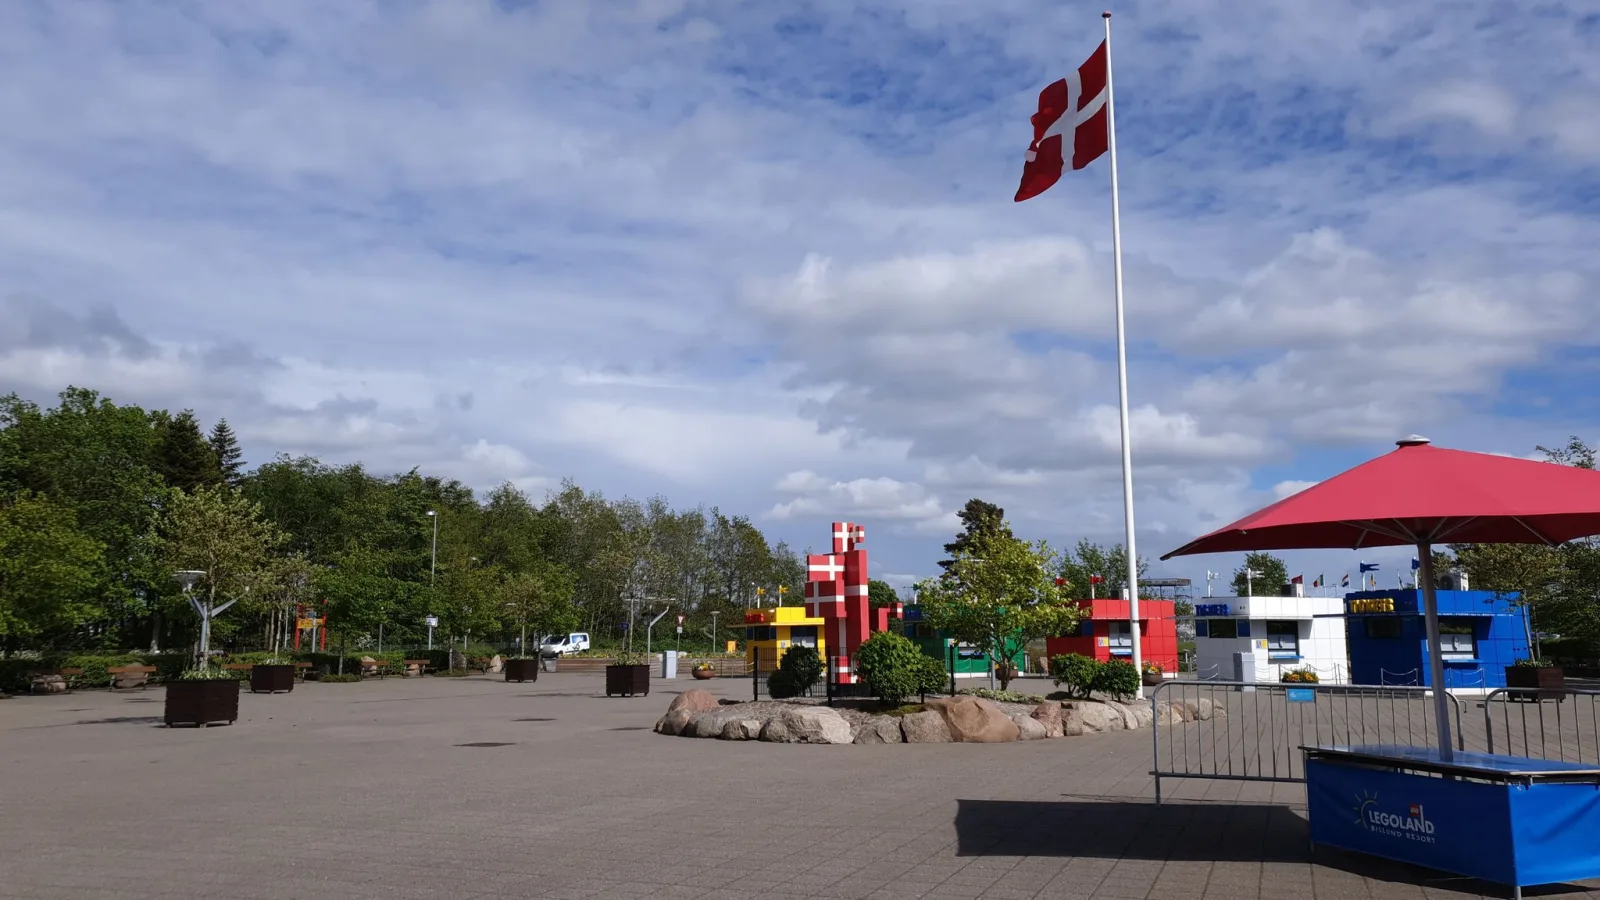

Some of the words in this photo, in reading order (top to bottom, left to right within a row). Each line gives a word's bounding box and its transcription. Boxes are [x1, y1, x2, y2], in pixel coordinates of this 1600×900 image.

[1368, 804, 1435, 833] LEGOLAND
[1371, 826, 1402, 837] BILLUND
[1406, 833, 1435, 843] RESORT
